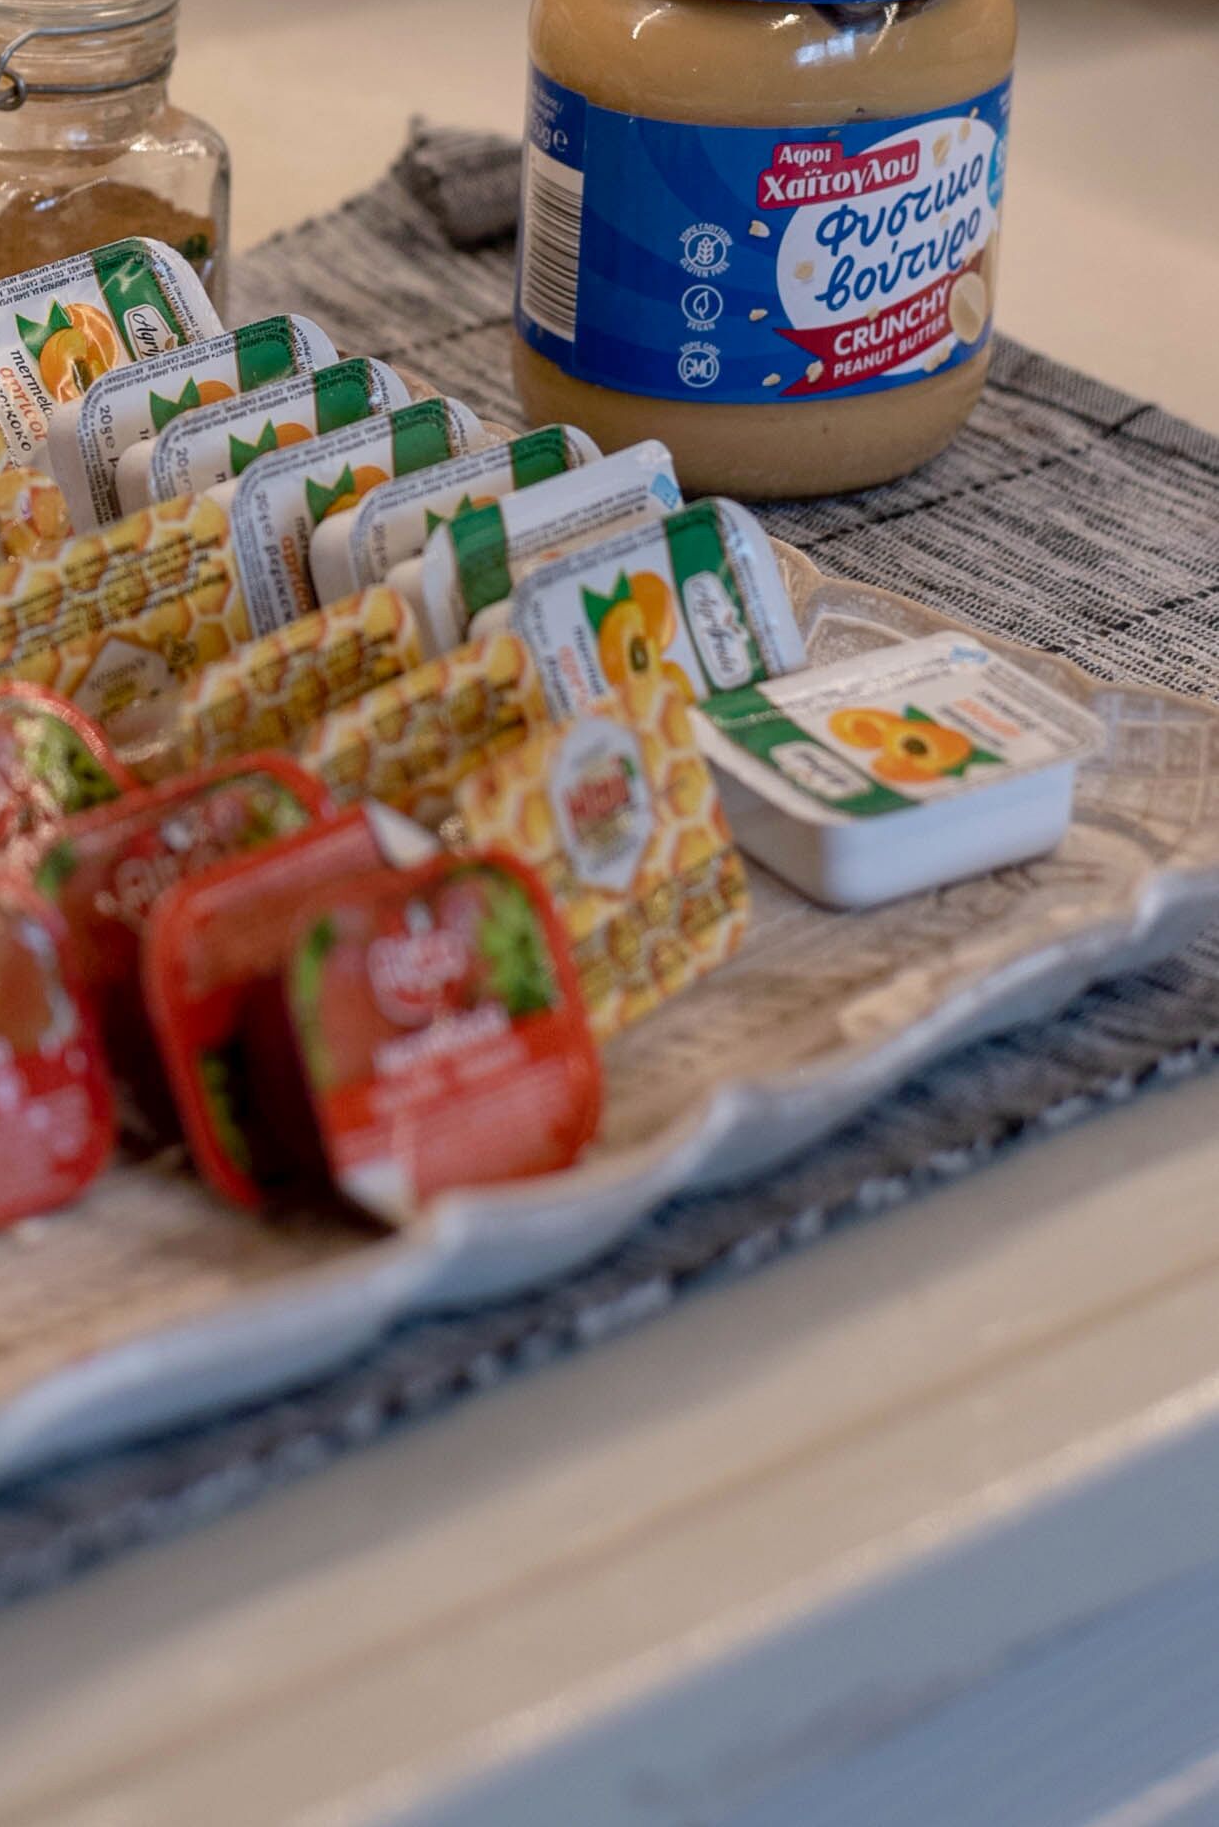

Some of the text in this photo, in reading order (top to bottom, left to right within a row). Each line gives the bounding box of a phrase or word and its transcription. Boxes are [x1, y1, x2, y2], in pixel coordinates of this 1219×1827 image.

[833, 279, 951, 357] CRUNCHY
[833, 313, 946, 379] PEANUT BUTTER
